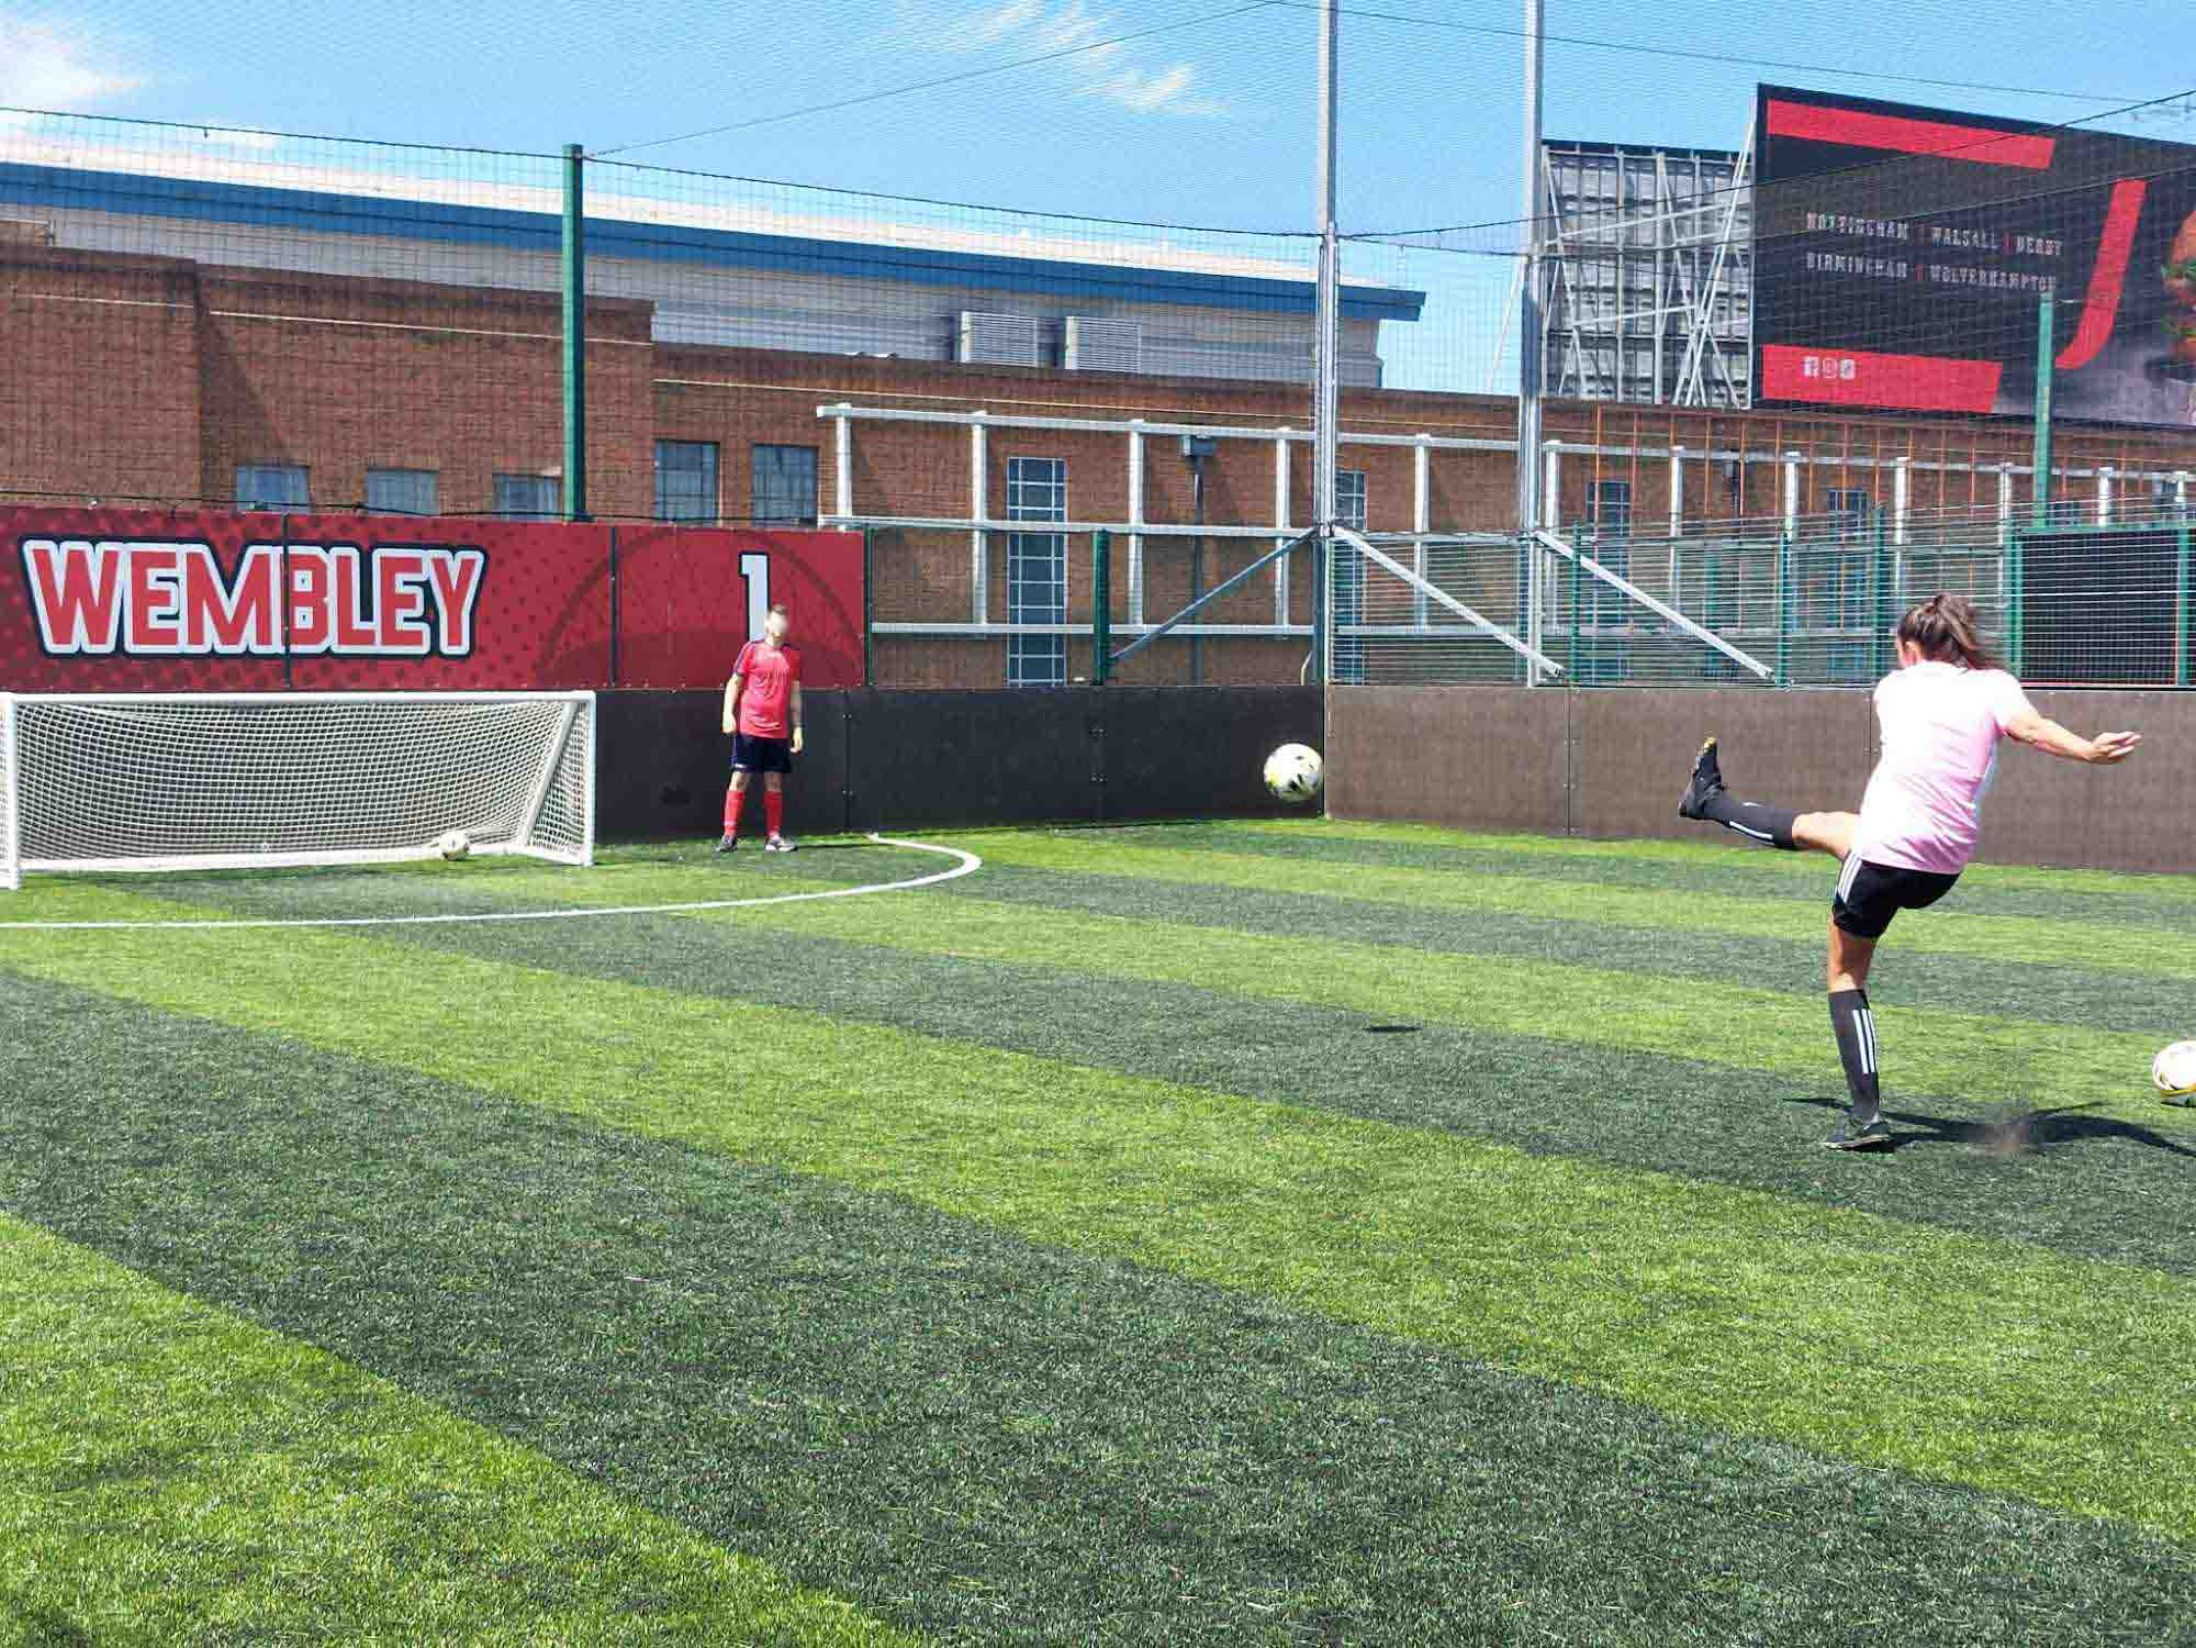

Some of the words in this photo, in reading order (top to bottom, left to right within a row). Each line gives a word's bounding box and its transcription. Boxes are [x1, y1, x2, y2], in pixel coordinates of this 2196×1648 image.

[1806, 252, 1907, 279] BIRMINGHAM
[1931, 226, 1998, 249] WALSALL
[2016, 235, 2063, 256] DERBY
[22, 540, 486, 656] WEMBLEY
[740, 553, 770, 641] 1
